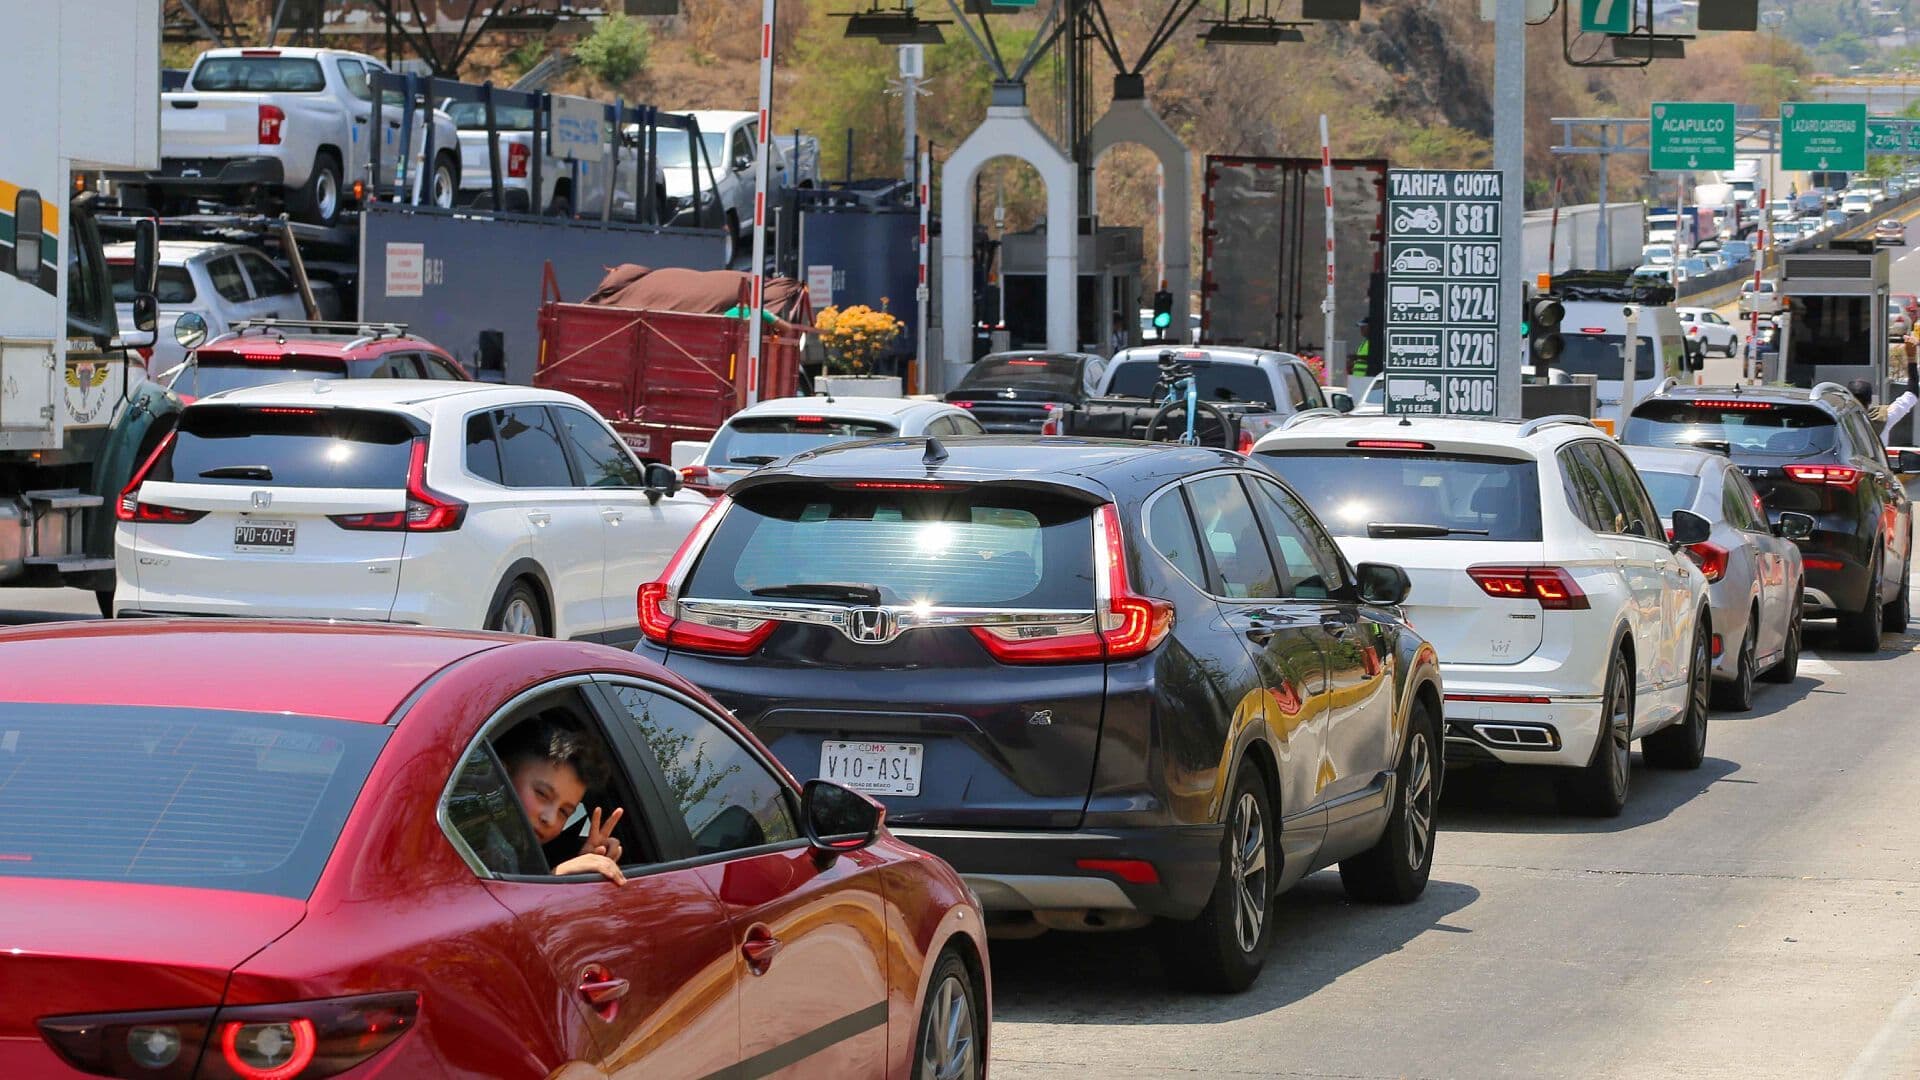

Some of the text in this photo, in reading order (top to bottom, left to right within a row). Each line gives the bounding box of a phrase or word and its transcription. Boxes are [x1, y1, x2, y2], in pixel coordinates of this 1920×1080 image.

[1661, 118, 1725, 132] ACAPULCO
[1390, 174, 1500, 197] TARIFA CUOTA
[1455, 204, 1494, 234] $81
[1451, 244, 1496, 276] $163
[1450, 285, 1495, 321] $224
[1450, 331, 1494, 367] $226
[1418, 358, 1438, 366] EJES
[1449, 377, 1494, 413] $306
[1414, 404, 1433, 412] EJES
[235, 527, 294, 544] PVD-670-E
[858, 744, 887, 752] CDMX
[828, 755, 912, 781] V10-ASL
